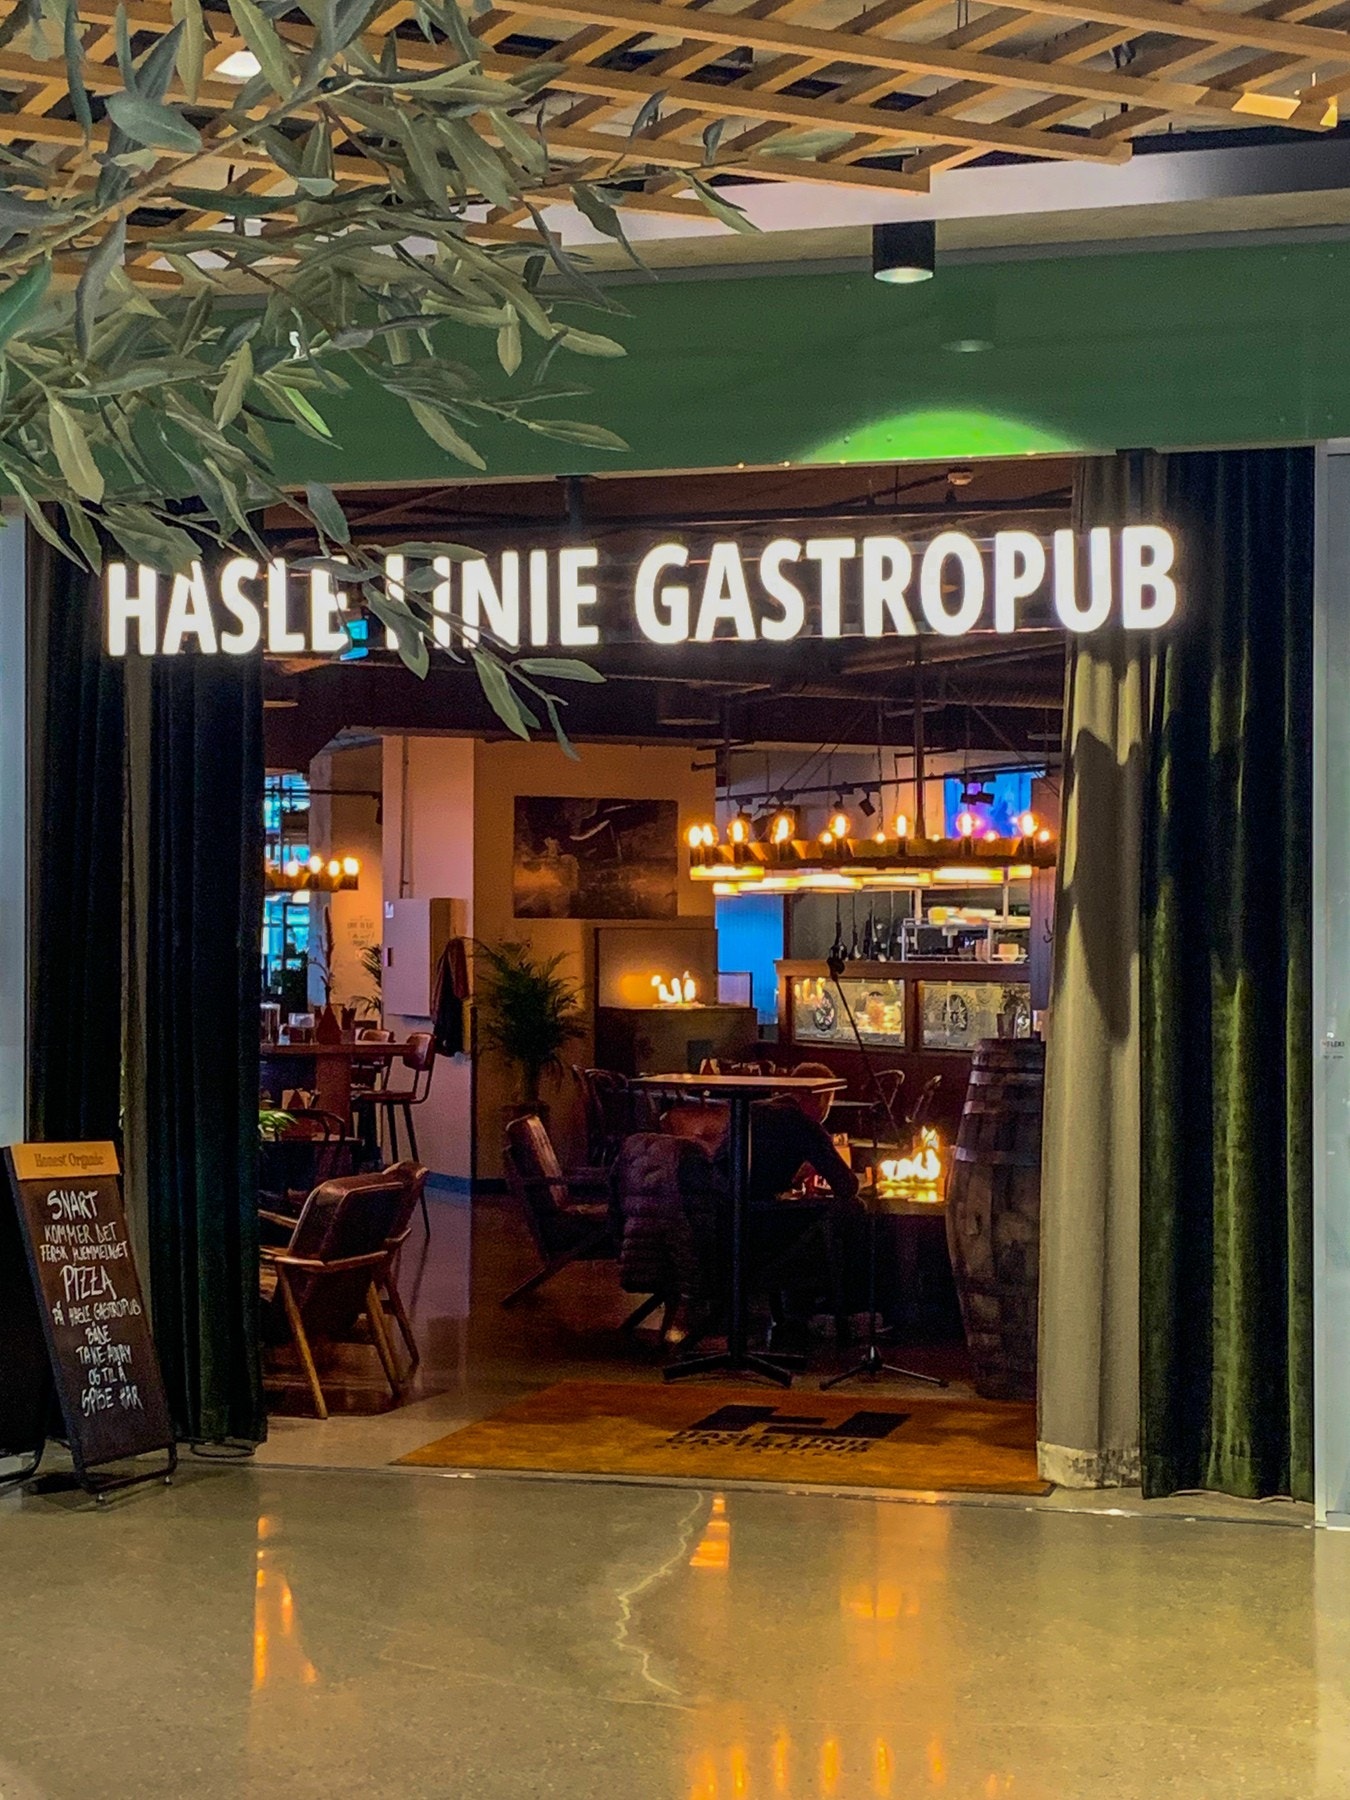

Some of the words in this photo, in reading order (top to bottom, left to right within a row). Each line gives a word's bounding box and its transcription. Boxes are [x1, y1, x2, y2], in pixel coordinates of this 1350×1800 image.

[107, 557, 351, 656] HASLE
[634, 524, 1178, 645] GASTROPUB
[34, 1153, 66, 1168] Honest
[46, 1189, 98, 1221] SNART
[44, 1223, 93, 1246] KOMMER
[95, 1221, 117, 1244] DET
[59, 1264, 118, 1302] PIZZA
[101, 1367, 118, 1383] TIL
